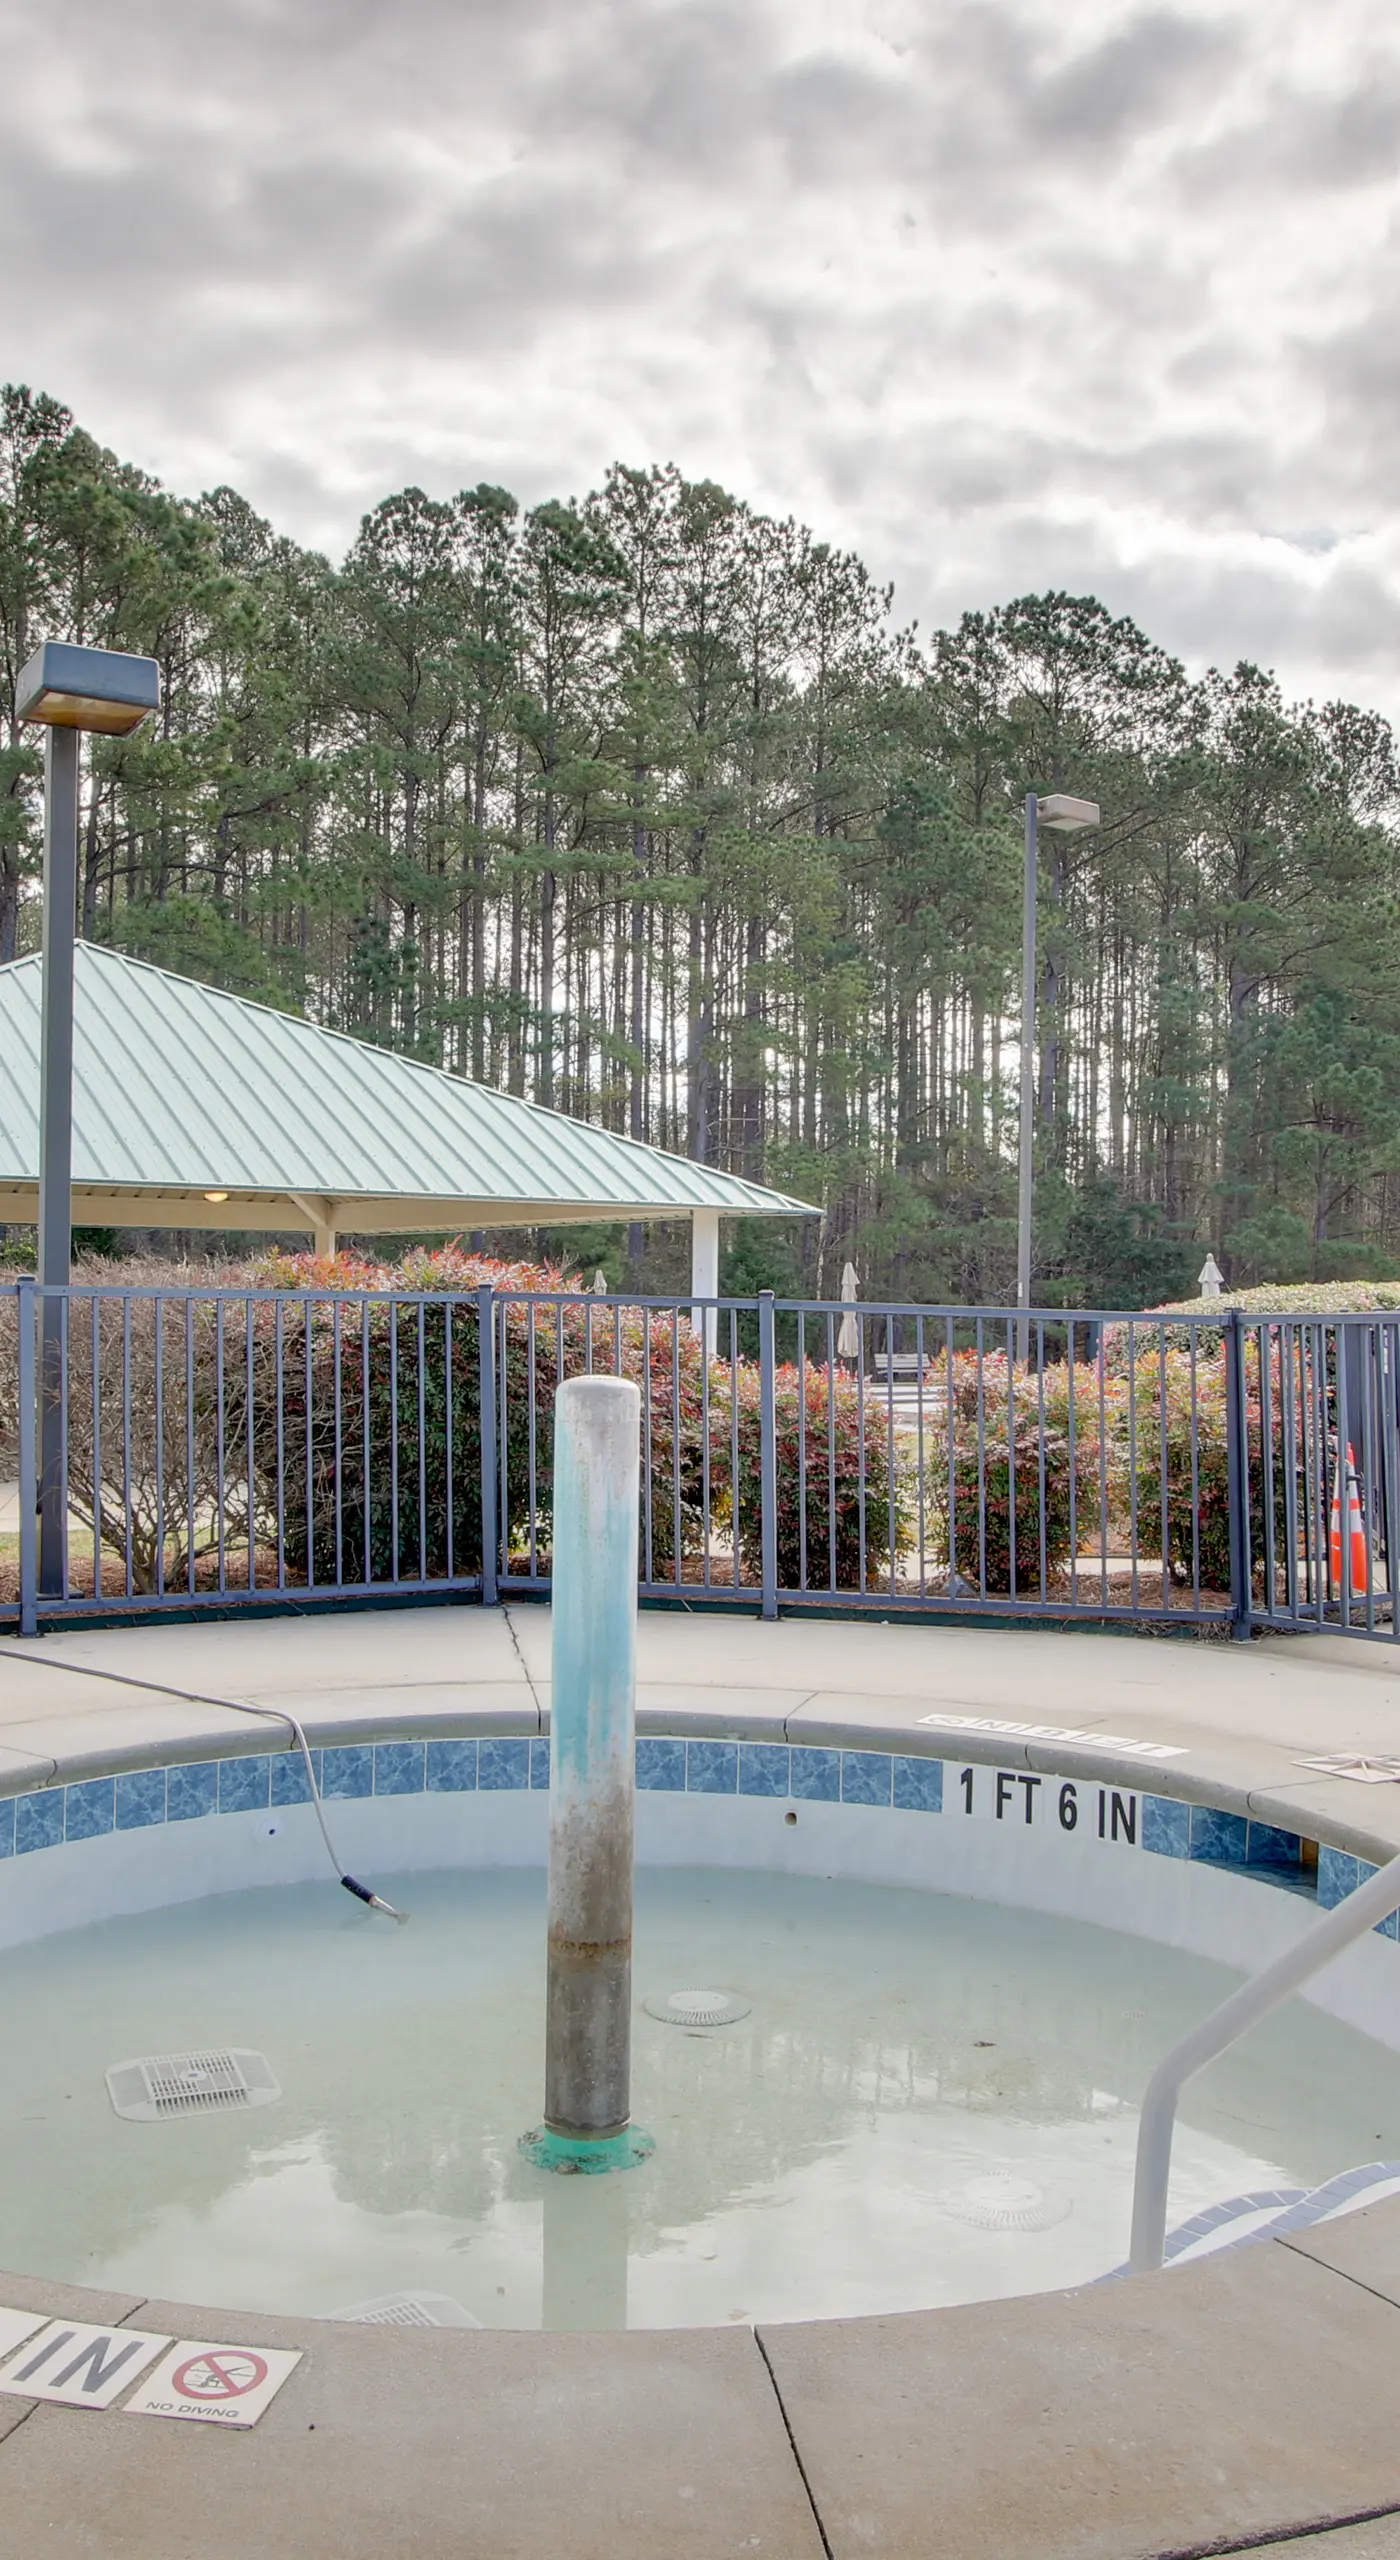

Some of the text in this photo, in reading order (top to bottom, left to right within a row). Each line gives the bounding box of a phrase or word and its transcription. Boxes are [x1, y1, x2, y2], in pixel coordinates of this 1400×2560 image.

[978, 1721, 1020, 1732] IN
[960, 1768, 1136, 1844] 1 FT 6 IN
[11, 2331, 145, 2393] IN
[145, 2401, 240, 2418] NO DIVING
